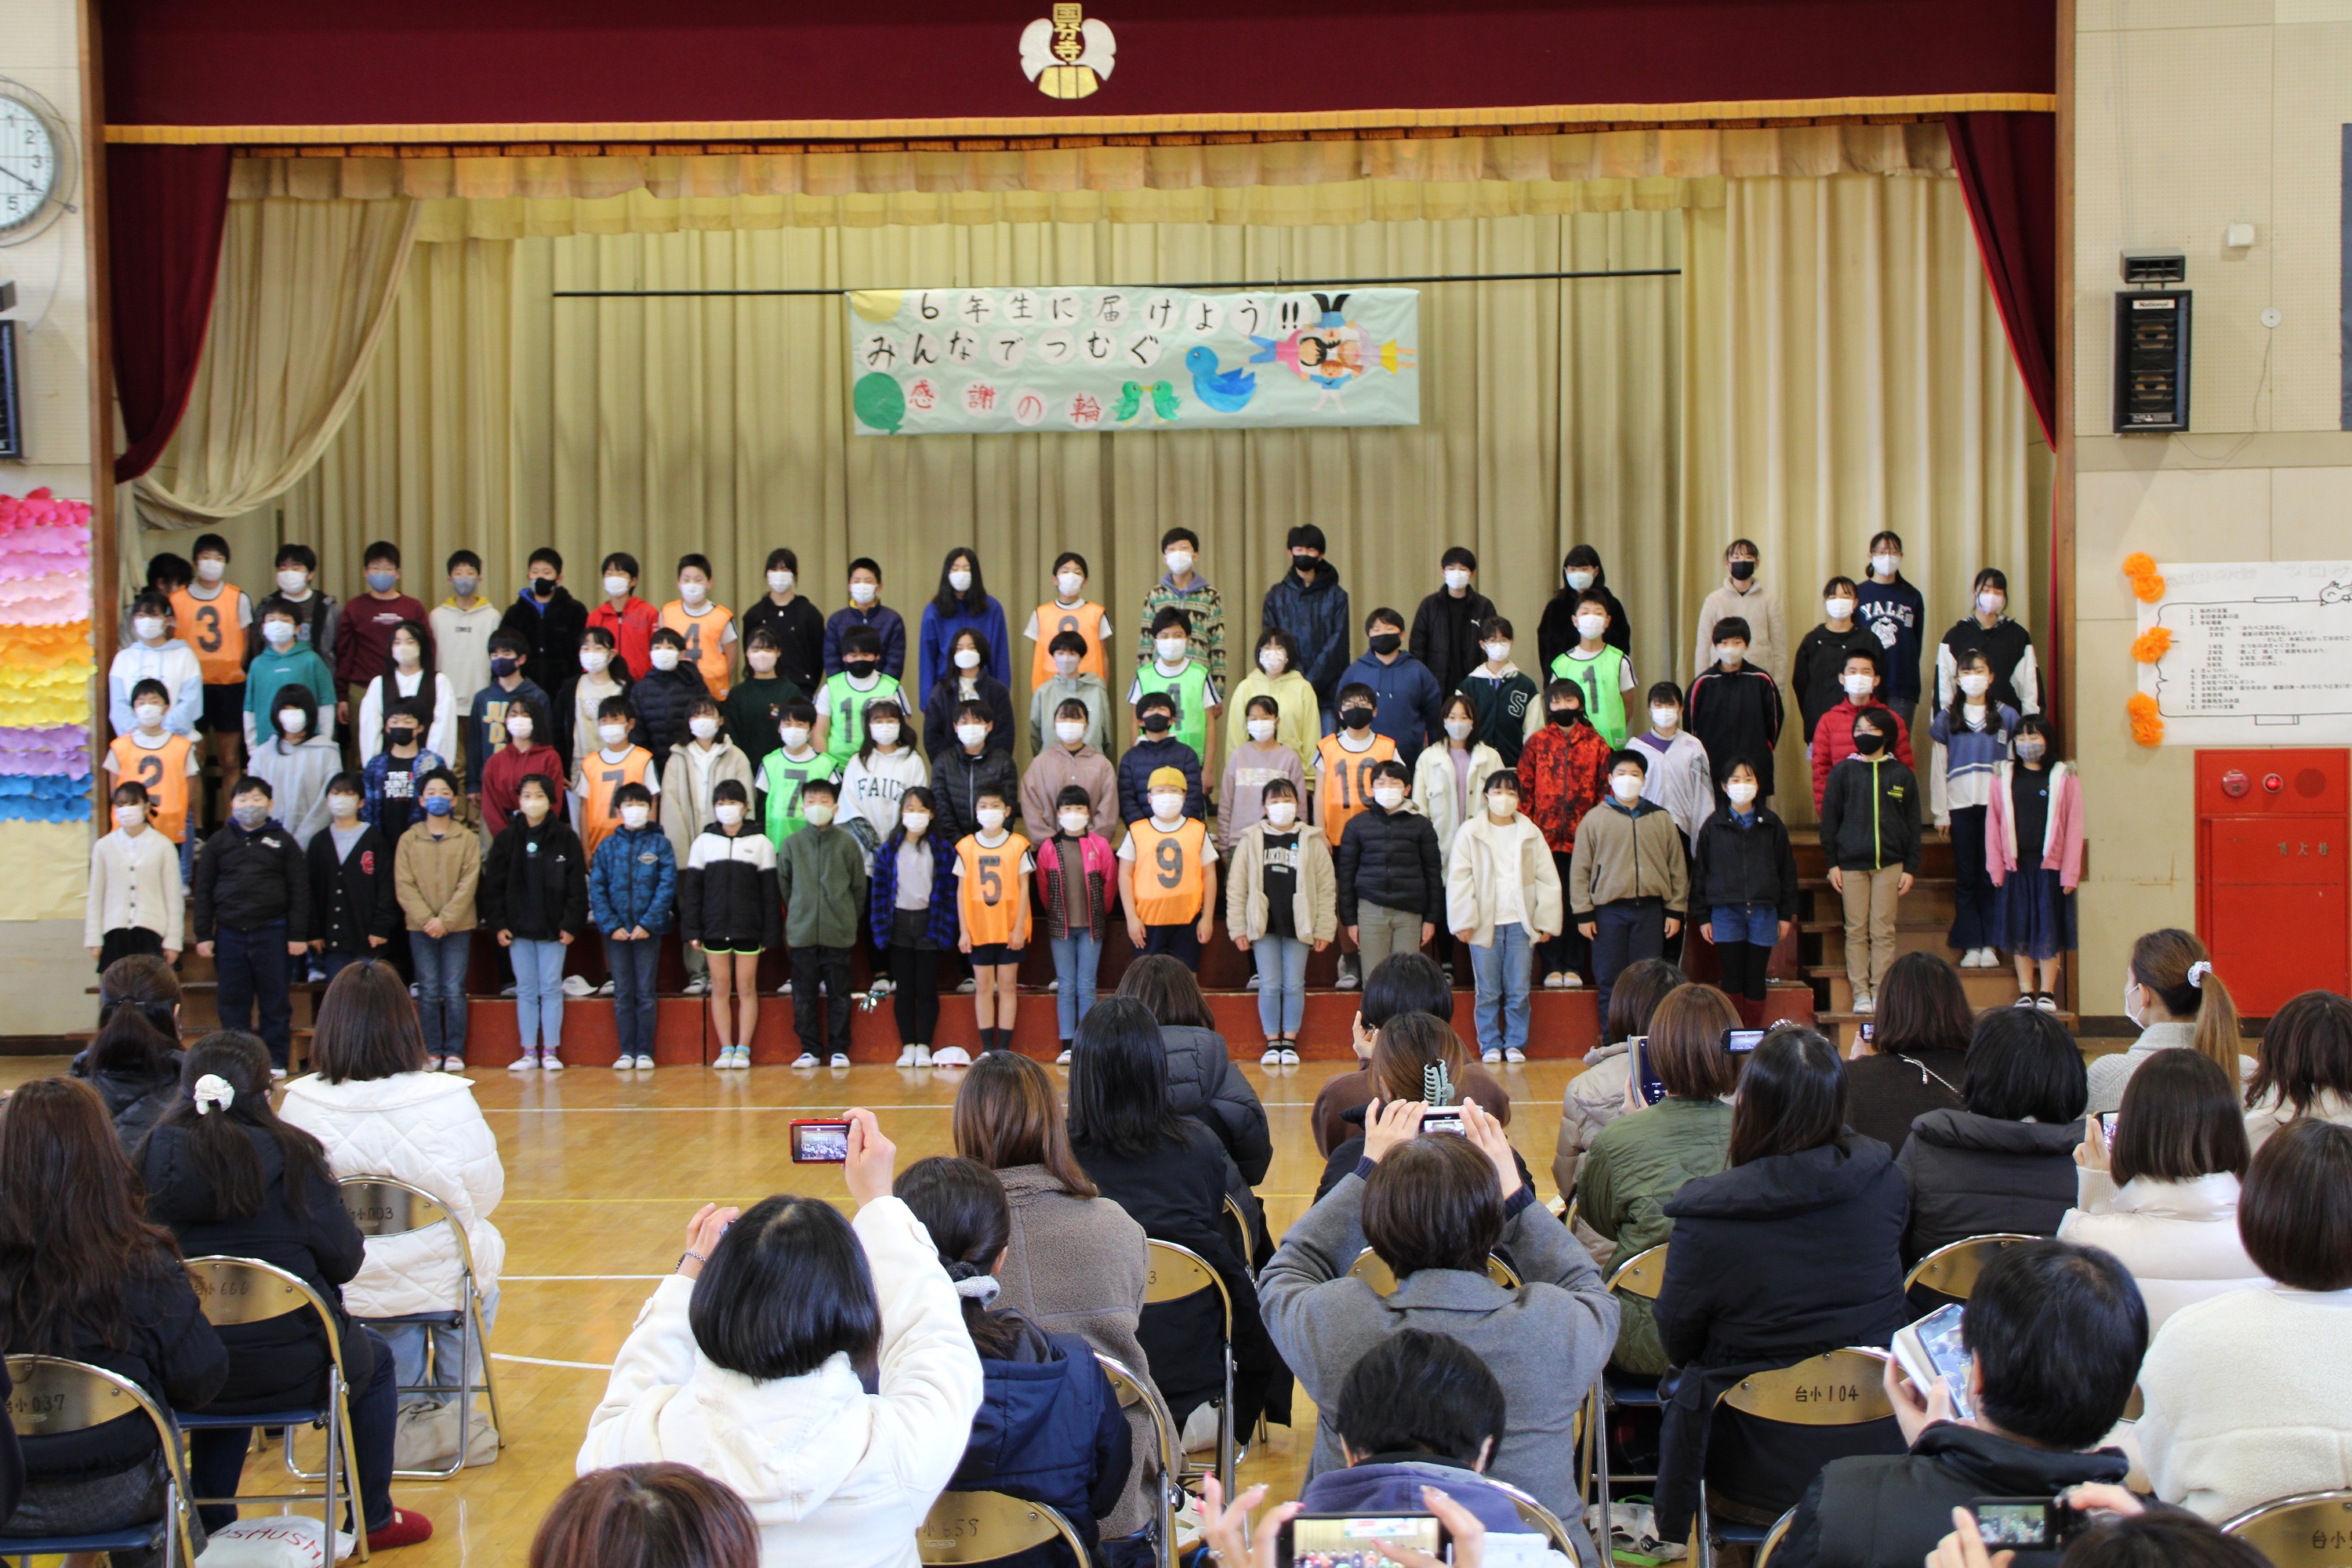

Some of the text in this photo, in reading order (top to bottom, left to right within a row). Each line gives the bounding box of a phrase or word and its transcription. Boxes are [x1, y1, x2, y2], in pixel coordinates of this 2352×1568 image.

[25, 129, 35, 144] 2
[31, 154, 42, 169] 3
[8, 196, 18, 210] 5
[867, 331, 1159, 368] みんなでつむぐ
[908, 377, 1102, 424] 感謝の輪
[197, 605, 223, 652] 3
[1860, 601, 1906, 621] YALE
[684, 622, 703, 664] 4
[1508, 689, 1528, 718] S
[1582, 665, 1599, 713] 1
[138, 754, 164, 808] 2
[602, 769, 625, 818] 7
[785, 769, 808, 818] 7
[978, 855, 1002, 907] 5
[1156, 837, 1183, 888] 9
[1795, 1385, 1860, 1403] 台小104
[924, 1518, 979, 1537] 小658
